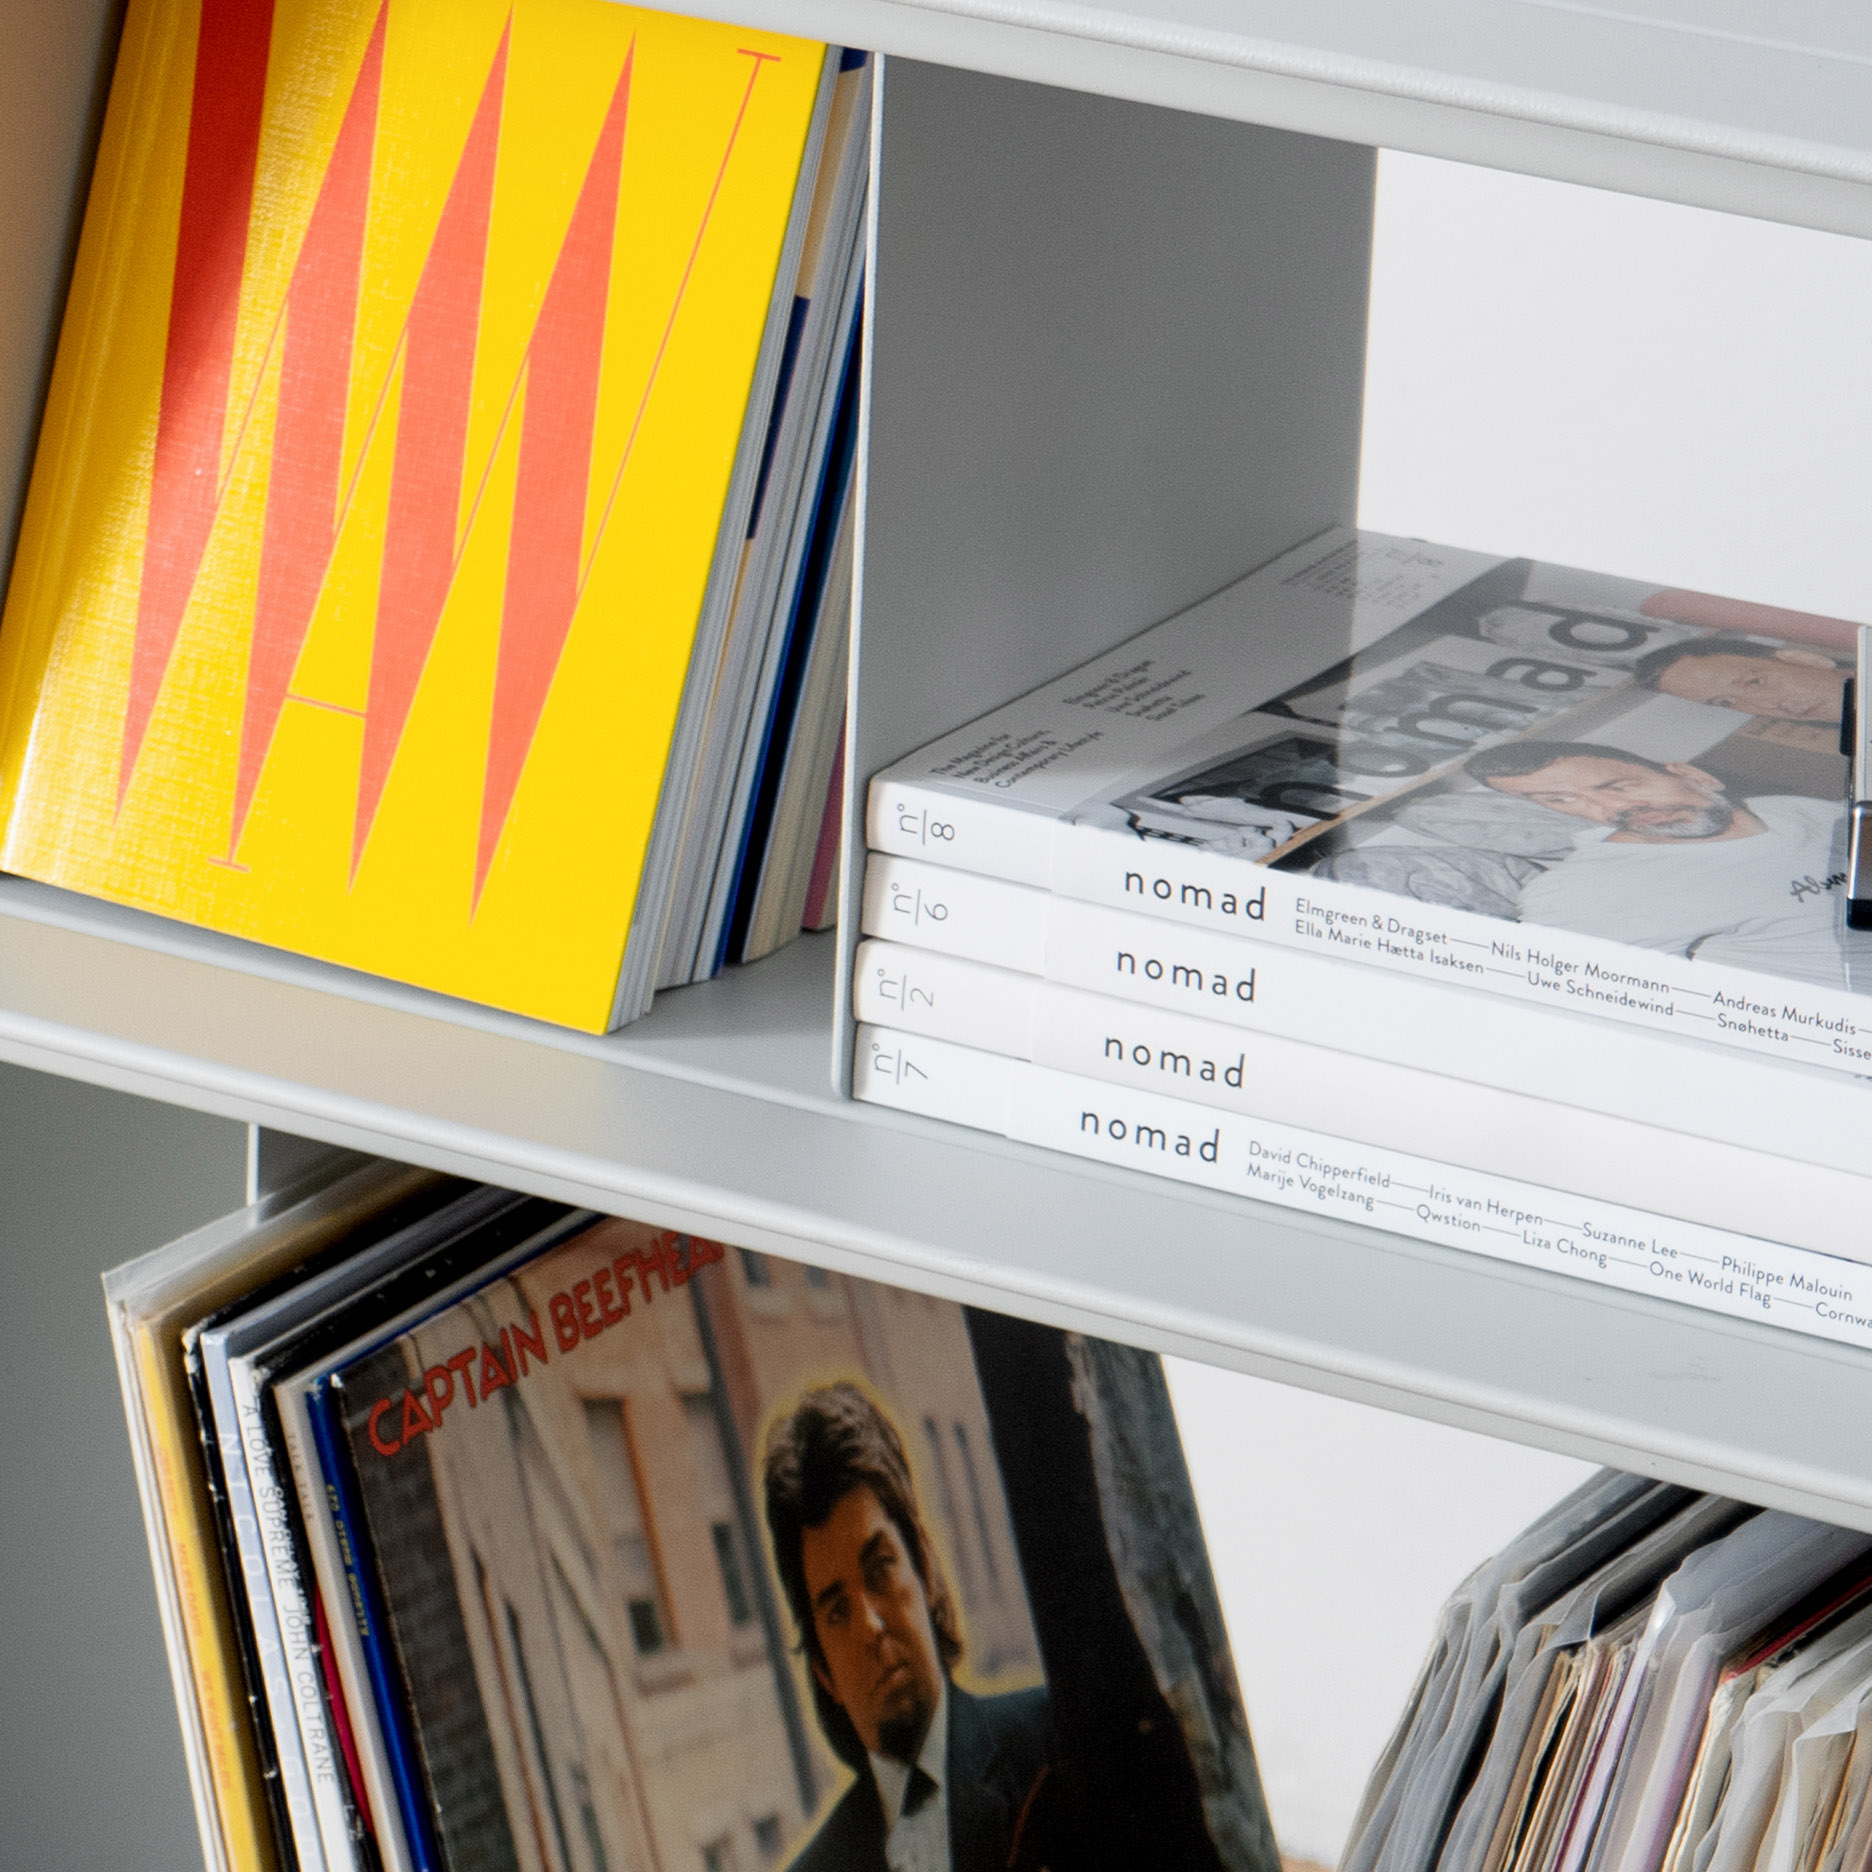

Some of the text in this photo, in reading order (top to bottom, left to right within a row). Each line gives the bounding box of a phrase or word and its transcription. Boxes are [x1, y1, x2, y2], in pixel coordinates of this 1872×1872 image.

[1259, 600, 1662, 820] nomad
[1125, 871, 1267, 922] nomad
[1117, 952, 1257, 1003] nomad
[1295, 919, 1323, 939] Ella
[1328, 928, 1372, 949] Marie
[1378, 938, 1425, 961] Hætta
[1430, 949, 1485, 974] Isaksen
[1528, 970, 1561, 992] Uwe
[1566, 979, 1674, 1017] Schneidewind
[1717, 1013, 1789, 1042] Snøhetta
[1296, 898, 1856, 1036] Elmgreen & Dragset Nils Holger Moormann Andreas Murkudis
[1104, 1037, 1245, 1088] nomad
[1081, 1111, 1220, 1163] nomad
[1246, 1163, 1294, 1190] Marije
[1299, 1175, 1375, 1212] Vogelzang
[1416, 1204, 1481, 1232] Qwstion
[1523, 1230, 1552, 1250] Liza
[1556, 1238, 1607, 1269] Chong
[1649, 1261, 1683, 1282] One
[1688, 1269, 1734, 1295] World
[1739, 1282, 1772, 1310] Flag
[1249, 1140, 1853, 1302] David Chipperfield Iris van Herpen Suzanne Lee Philippe Malouin
[242, 1403, 258, 1418] A
[368, 1310, 548, 1456] CAPTAIN
[246, 1426, 268, 1477] LOVE
[259, 1487, 295, 1589] SUPREME
[283, 1607, 311, 1662] JOHN
[296, 1665, 335, 1784] COLTRANE
